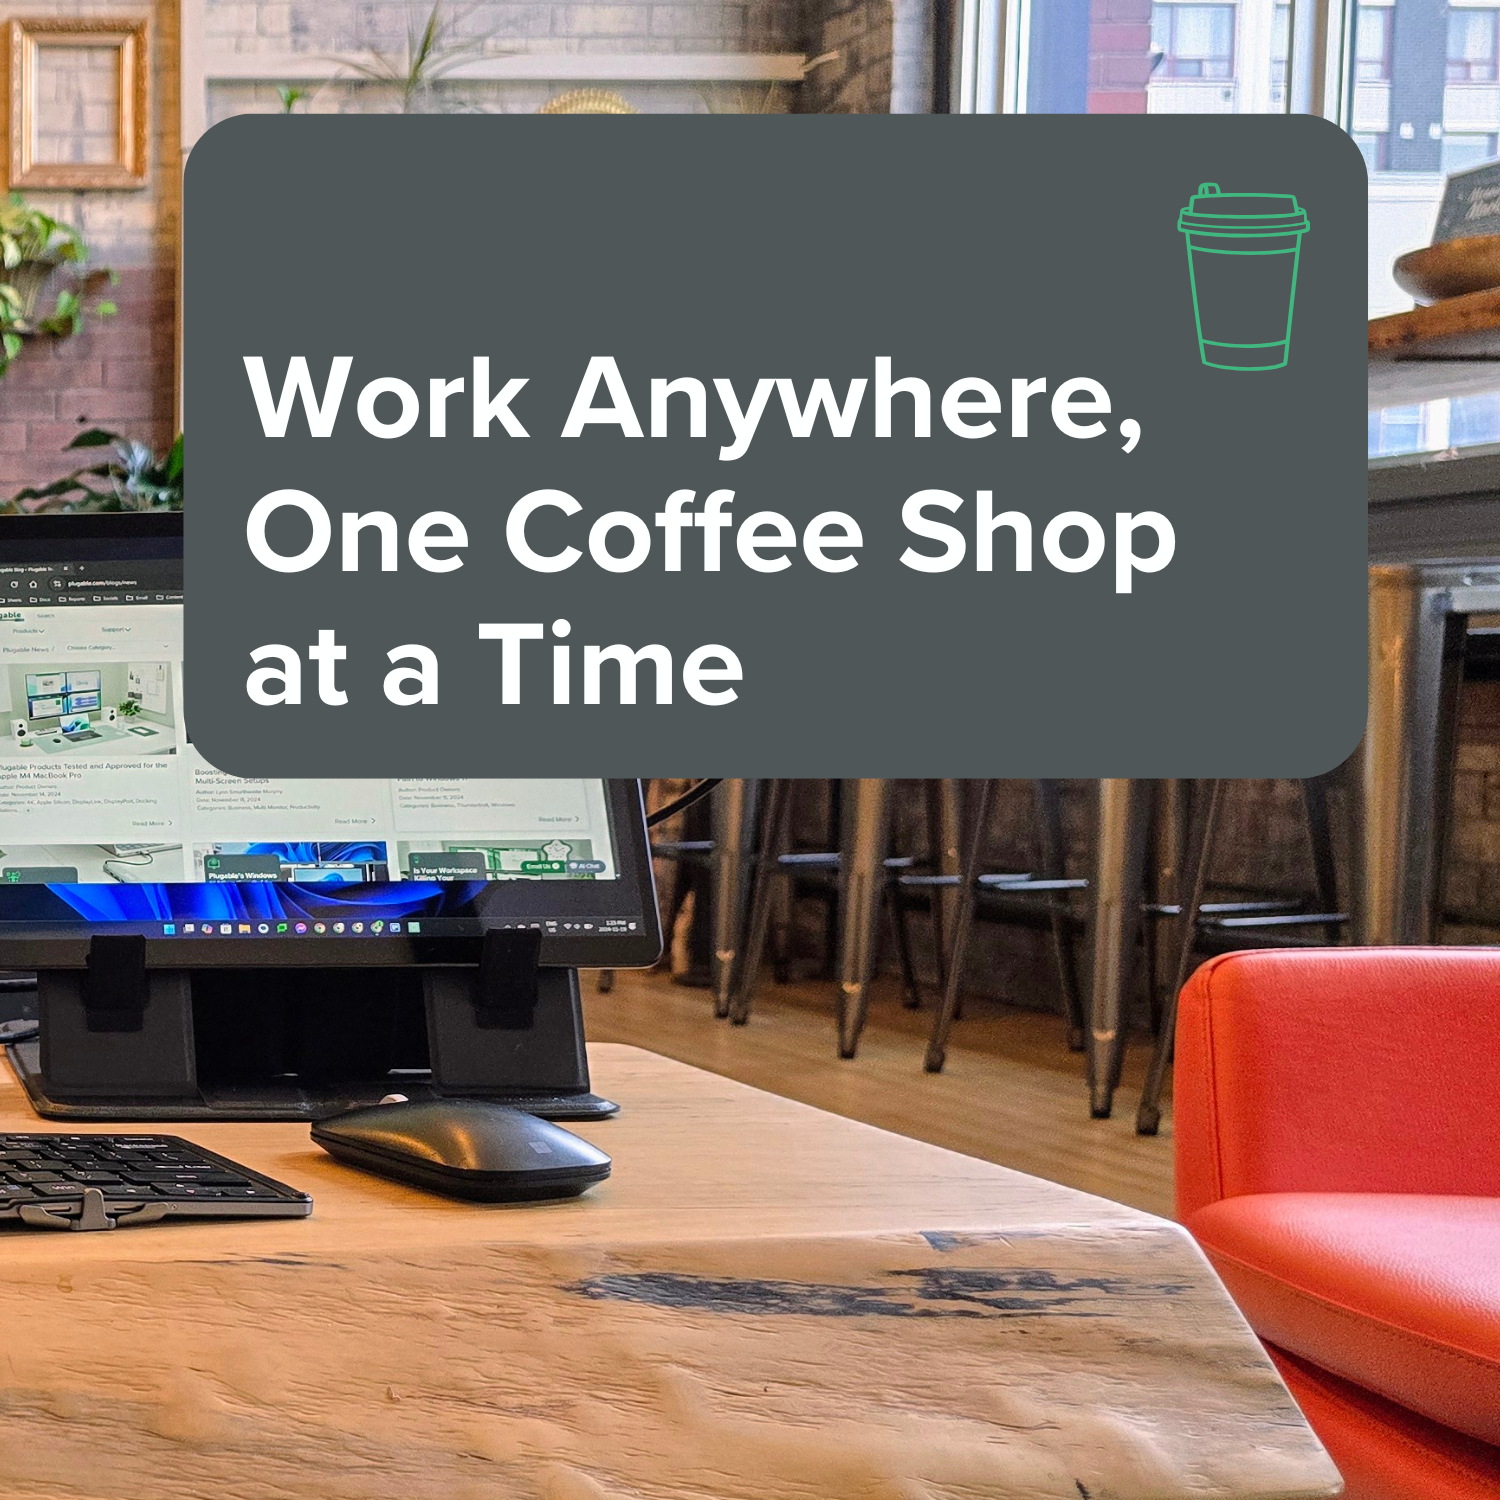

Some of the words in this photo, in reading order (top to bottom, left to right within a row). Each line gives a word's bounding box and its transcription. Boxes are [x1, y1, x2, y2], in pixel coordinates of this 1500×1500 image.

[105, 762, 142, 770] Approved
[195, 777, 242, 785] Multi-Screen
[439, 867, 478, 875] Workspace
[208, 872, 244, 880] Plugable's
